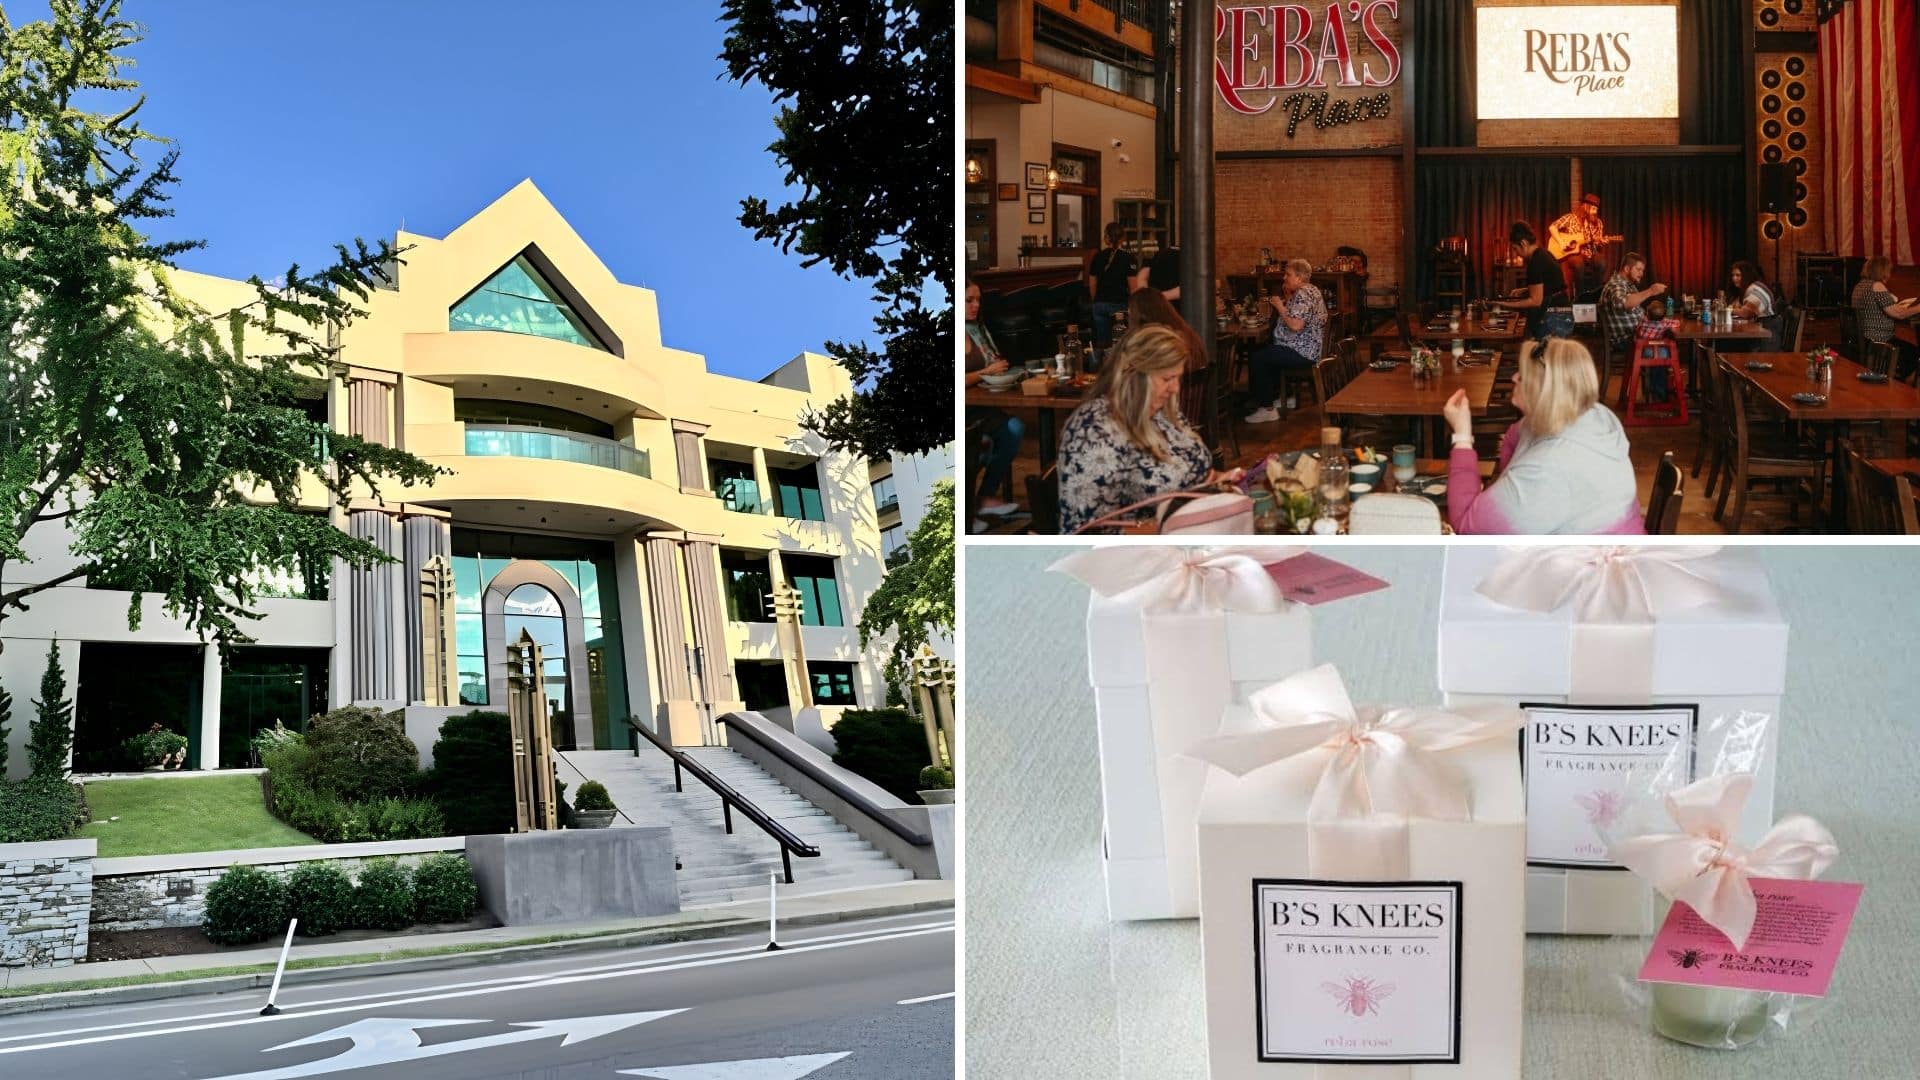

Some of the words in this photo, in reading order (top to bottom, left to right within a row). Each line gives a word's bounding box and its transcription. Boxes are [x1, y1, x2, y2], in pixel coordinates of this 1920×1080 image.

[1523, 29, 1631, 84] REBA'S
[1574, 75, 1625, 96] Place
[1283, 91, 1391, 139] Place
[1535, 722, 1576, 747] B'S
[1587, 724, 1681, 747] KNEES
[1545, 759, 1635, 772] FRAGRANCE
[1270, 901, 1320, 927] B'S
[1330, 903, 1444, 929] KNEES
[1285, 942, 1393, 955] FRAGRANCE
[1401, 944, 1431, 956] CO.
[1753, 956, 1813, 969] KNEES
